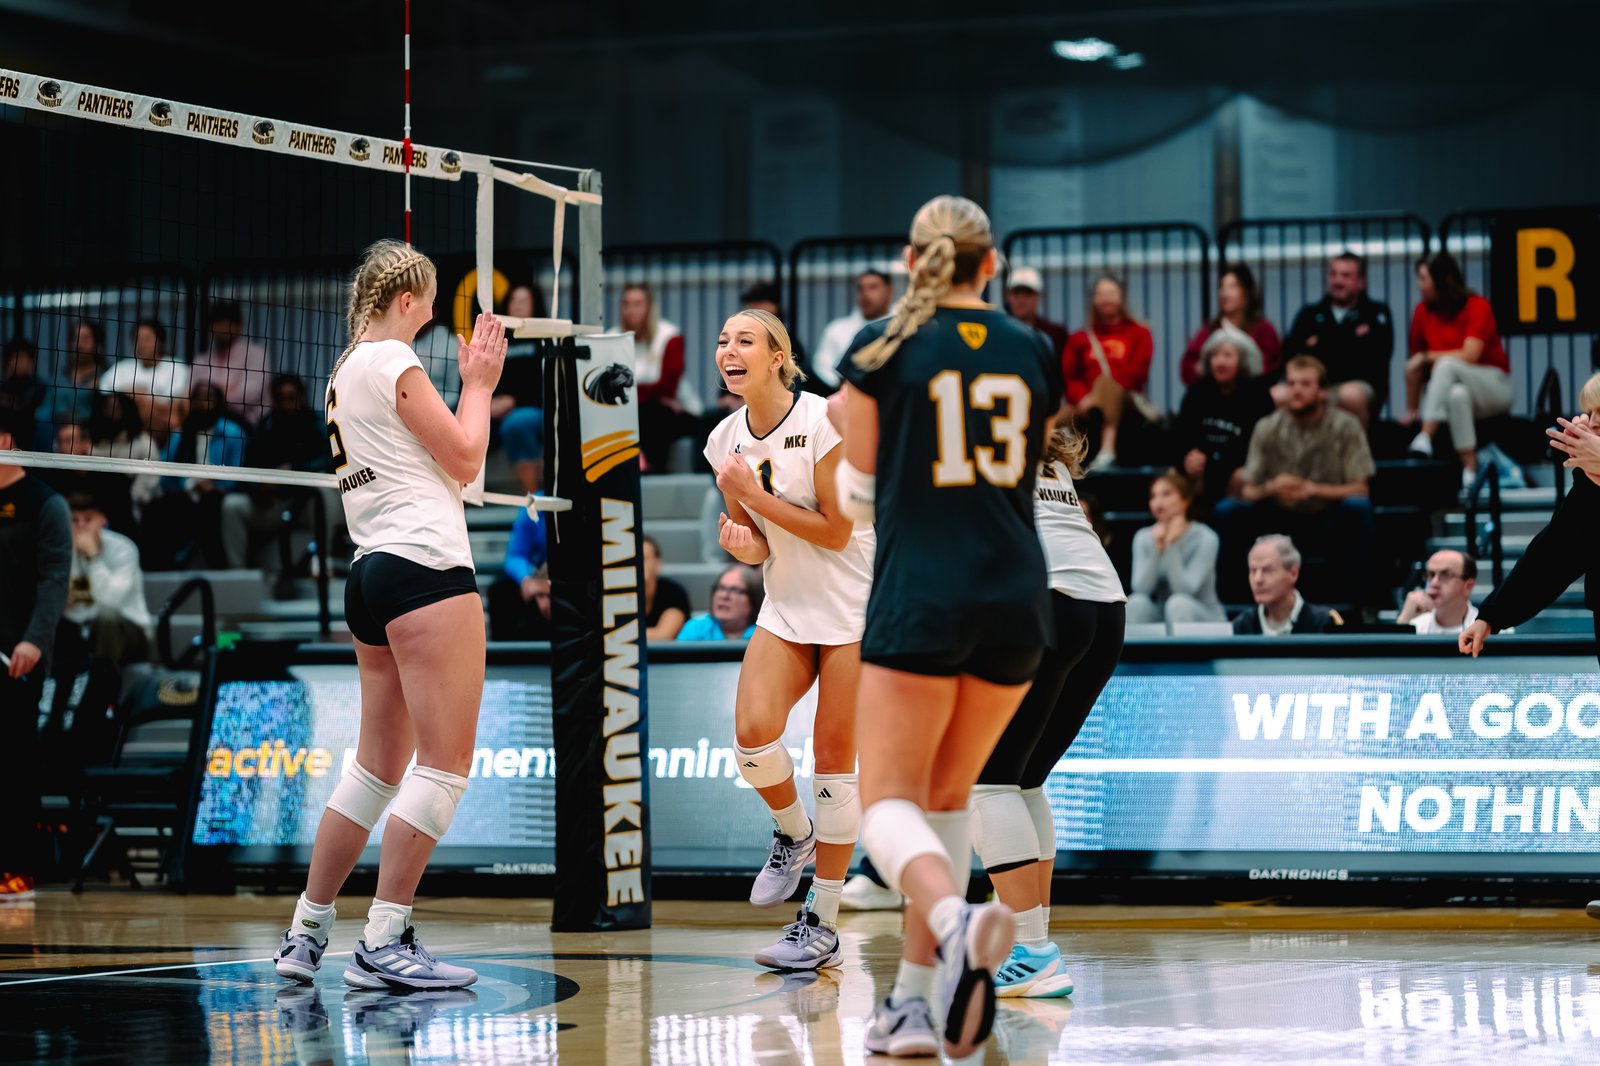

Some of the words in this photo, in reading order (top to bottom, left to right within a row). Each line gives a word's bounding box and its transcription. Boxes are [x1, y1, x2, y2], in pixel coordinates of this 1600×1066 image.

[77, 91, 134, 119] PANTHERS
[186, 112, 239, 138] PANTHERS
[288, 130, 337, 155] PANTHERS
[1516, 227, 1577, 322] R
[784, 434, 807, 450] MKE
[928, 369, 1032, 488] 13
[339, 467, 377, 495] AUKEE
[600, 497, 645, 907] MILWAUKEE
[1232, 693, 1393, 740] WITH
[1404, 693, 1453, 740] A
[206, 740, 333, 778] active
[1358, 785, 1600, 833] NOTHIN
[1249, 868, 1349, 881] DAKTRONICS
